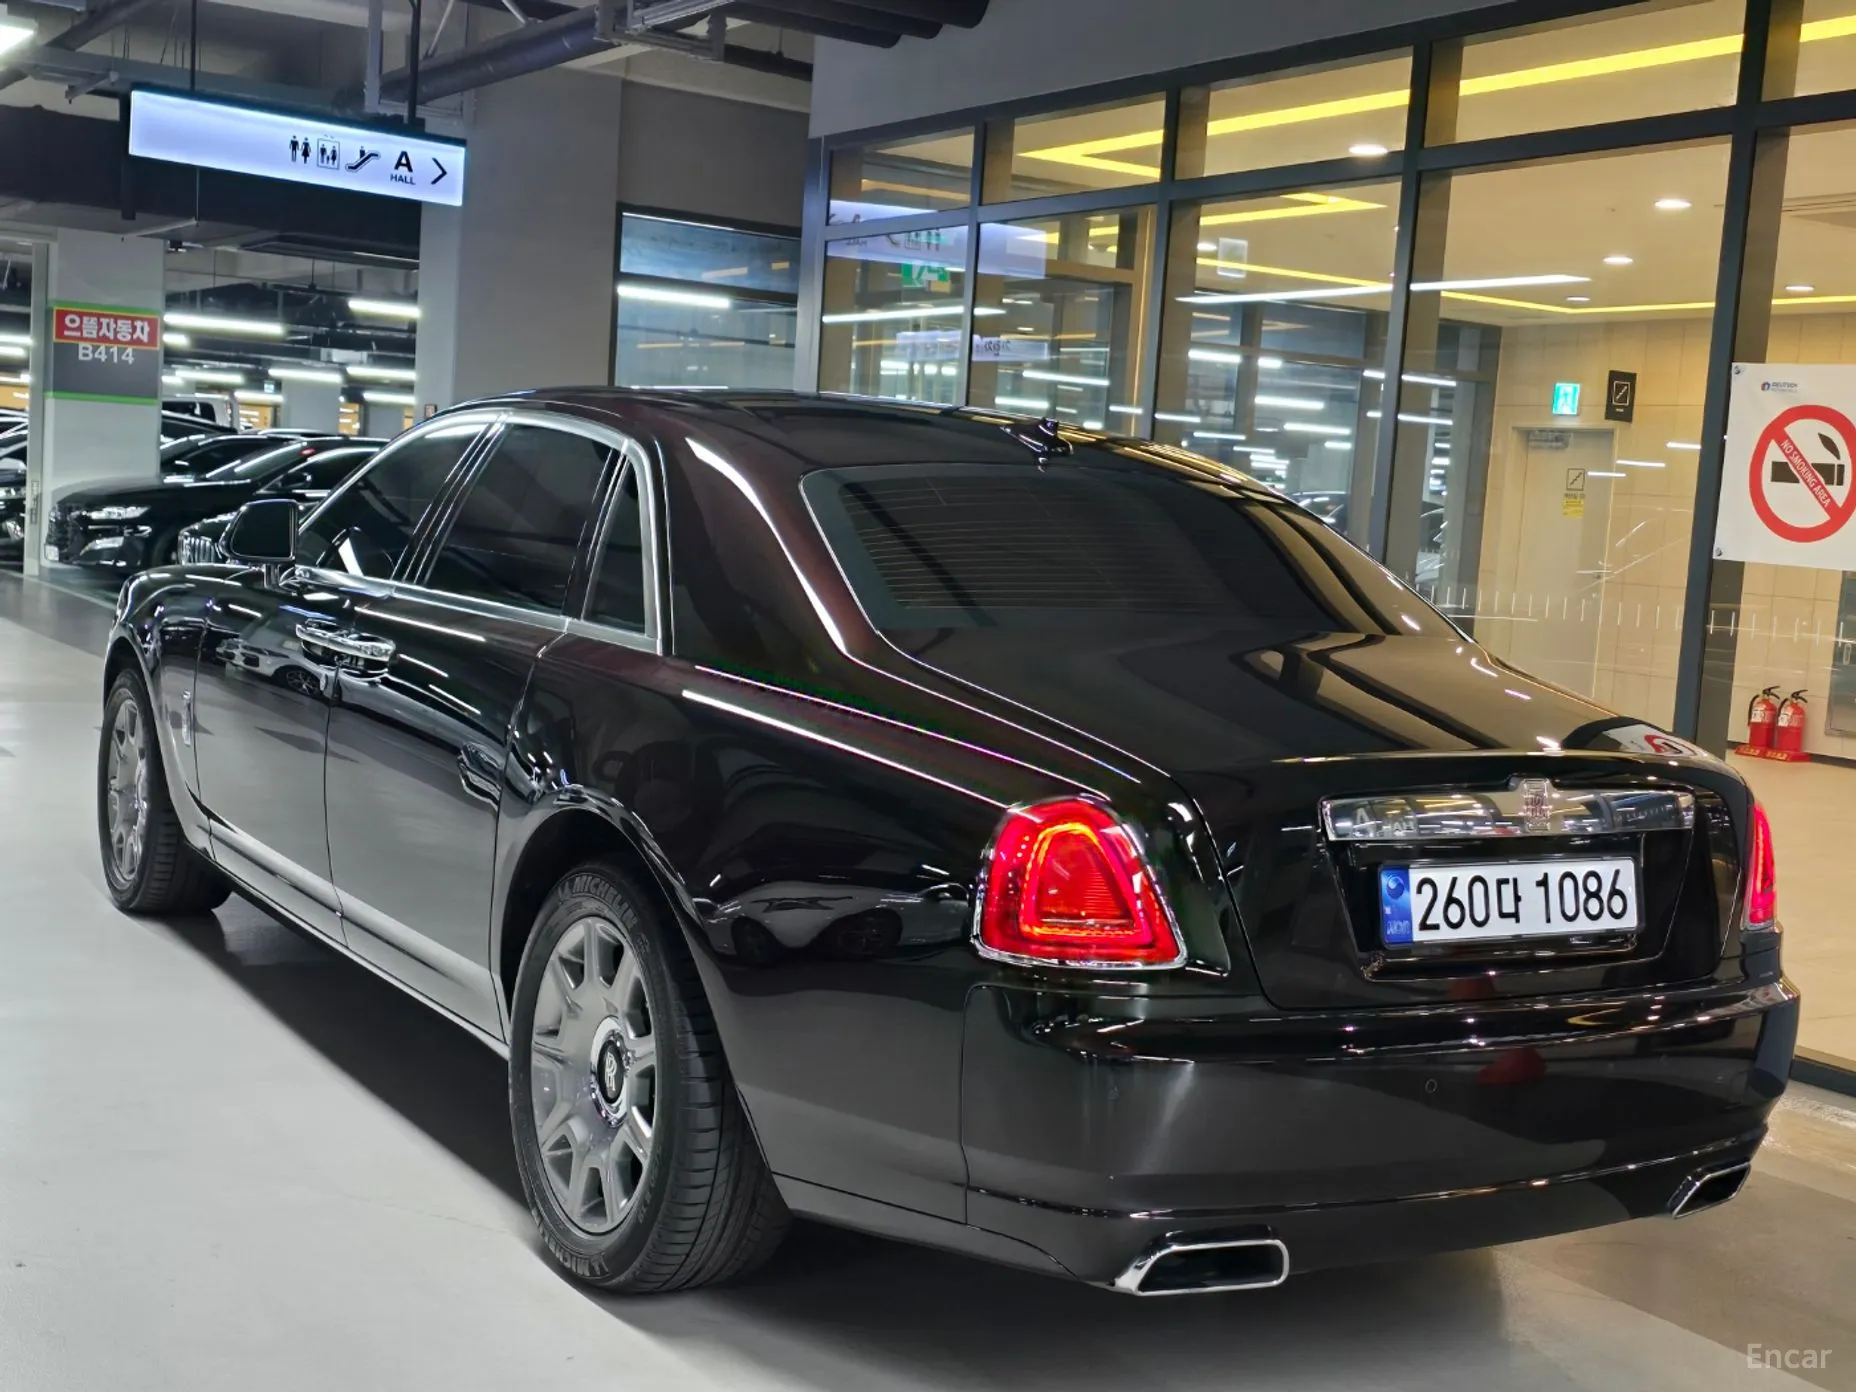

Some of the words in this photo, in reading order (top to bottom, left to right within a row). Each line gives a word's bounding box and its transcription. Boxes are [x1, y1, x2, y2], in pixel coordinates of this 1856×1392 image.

[393, 150, 414, 173] A
[389, 173, 416, 186] HALL
[63, 313, 150, 343] 으뜸자동차
[78, 343, 135, 365] B414
[1780, 439, 1794, 454] NO
[1789, 451, 1818, 488] SMOKING
[1813, 485, 1831, 508] AREA
[572, 874, 640, 930] MICHELIN
[1415, 874, 1522, 932] 260다
[1535, 868, 1629, 924] 1086
